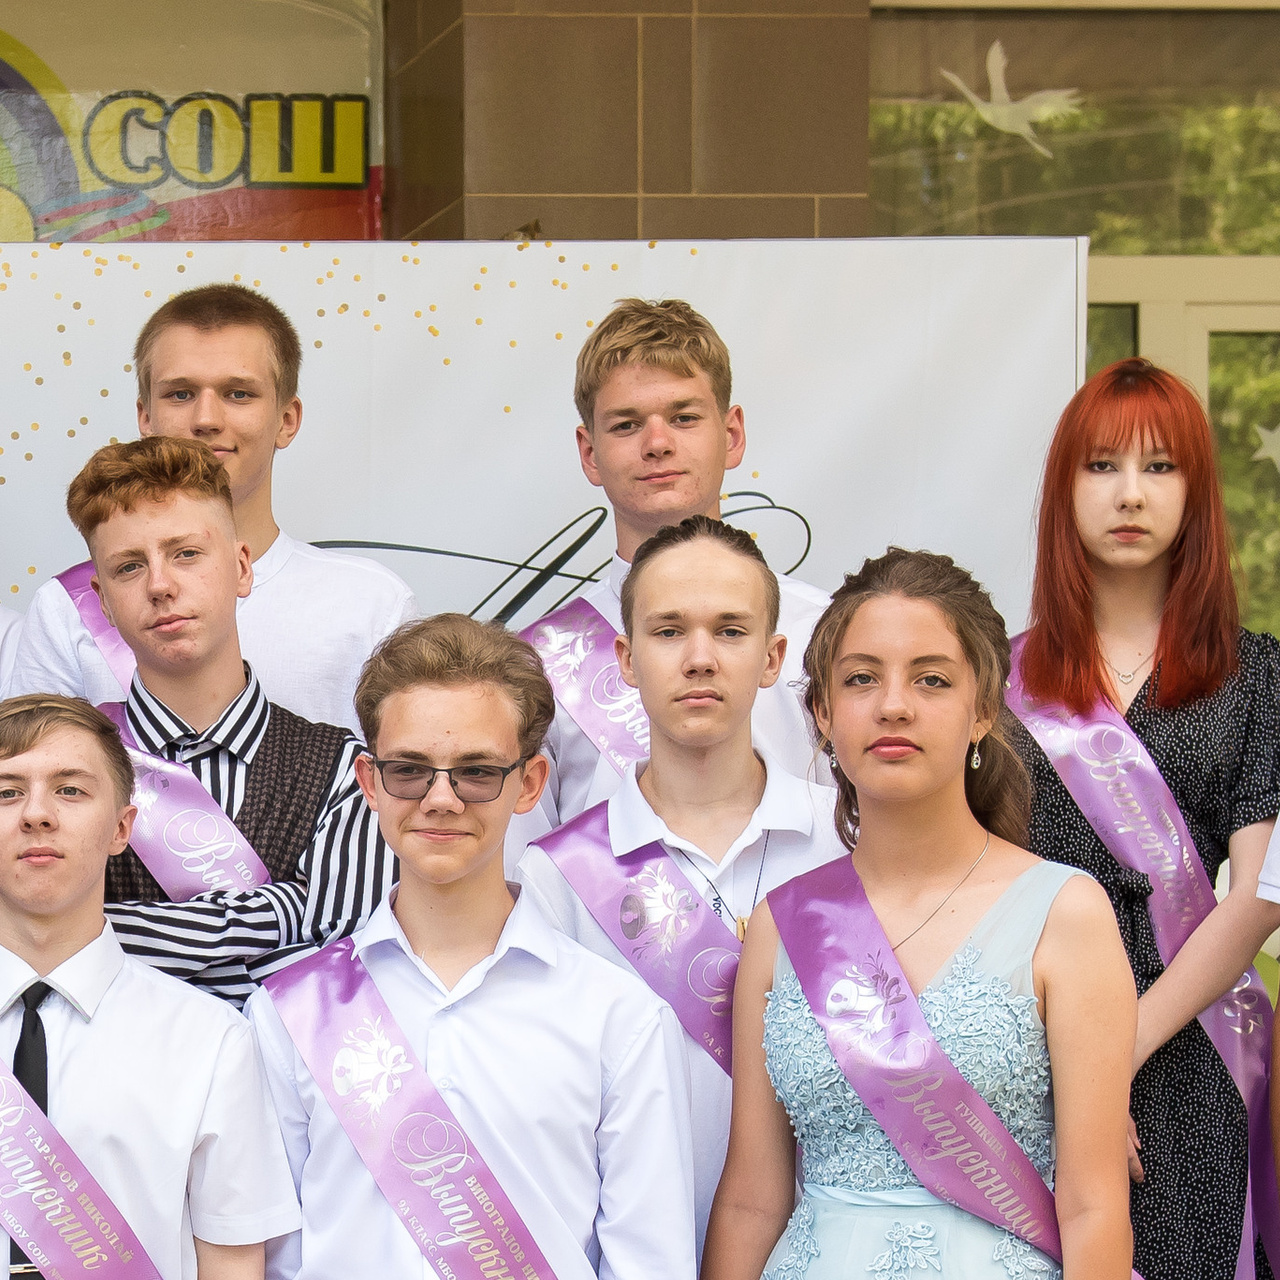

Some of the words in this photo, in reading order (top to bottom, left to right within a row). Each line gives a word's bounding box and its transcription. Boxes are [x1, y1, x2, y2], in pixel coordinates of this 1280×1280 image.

[83, 89, 370, 190] СОШ
[0, 1208, 30, 1240] МБОУ
[26, 1240, 52, 1268] СОШ
[23, 1124, 80, 1193] ТАРАСОВ
[77, 1192, 135, 1264] НИКОЛАЙ
[397, 1199, 411, 1216] 9А
[463, 1174, 527, 1264] ВИНОГРАДОВ
